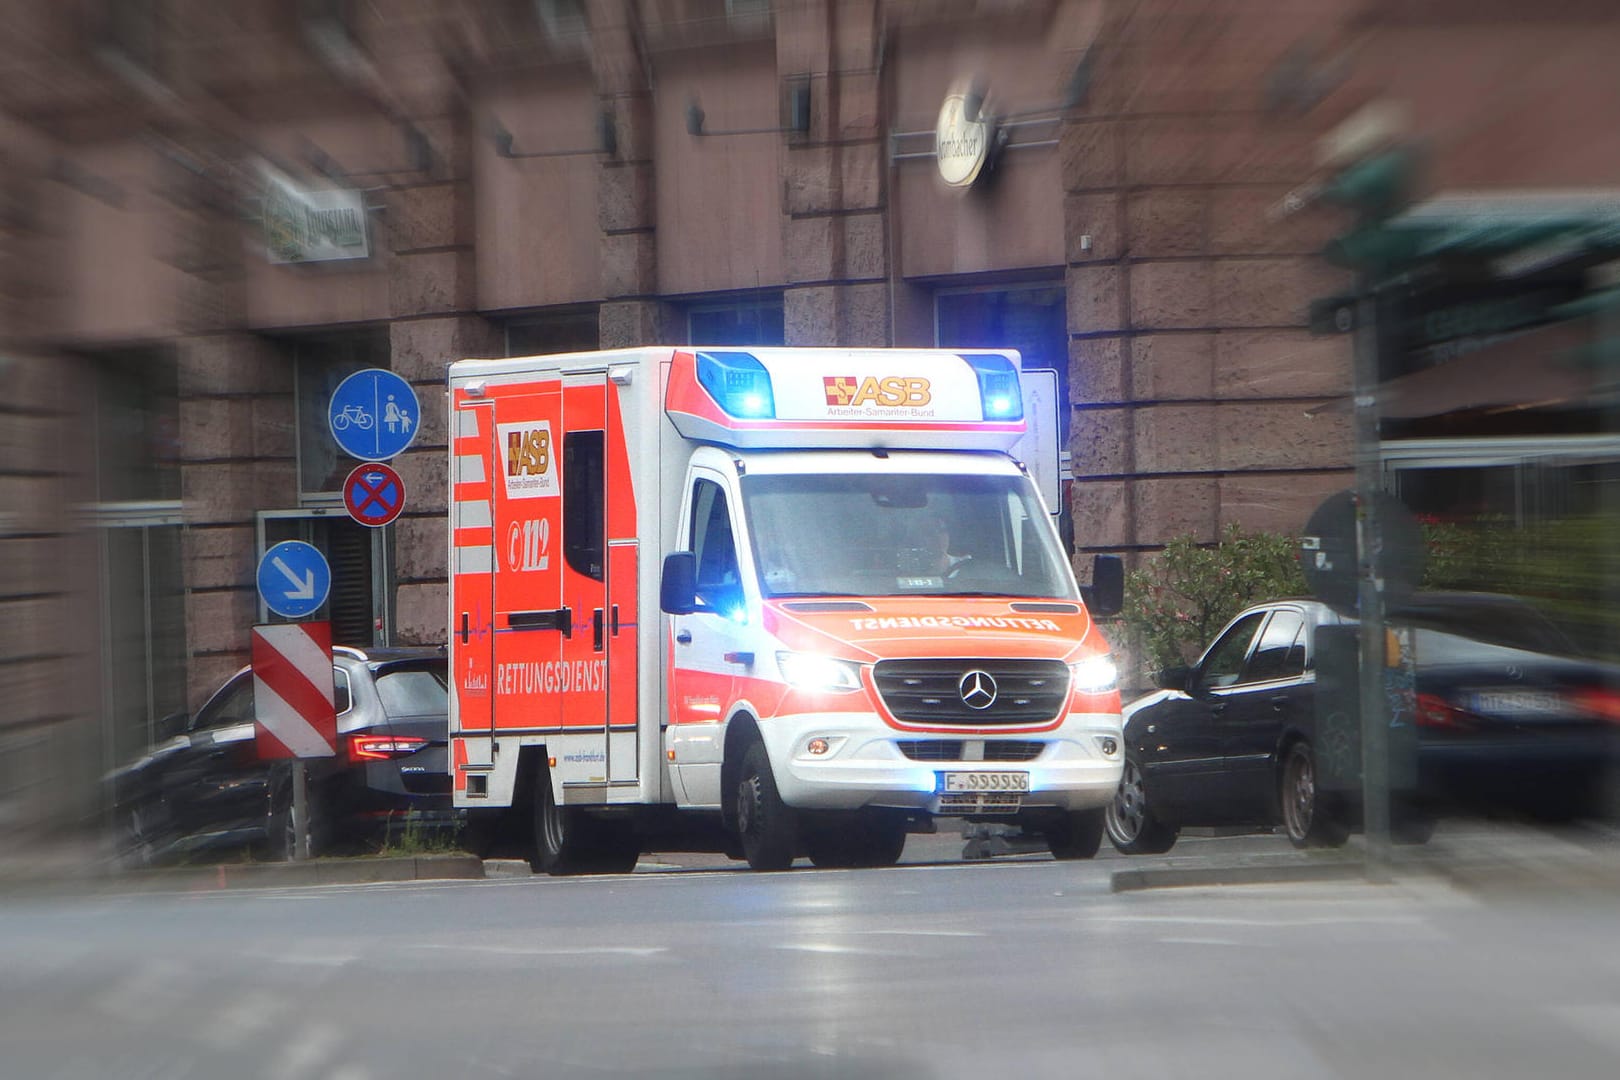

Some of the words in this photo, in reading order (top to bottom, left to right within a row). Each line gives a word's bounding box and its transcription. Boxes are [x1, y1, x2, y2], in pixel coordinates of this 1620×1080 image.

[852, 376, 932, 407] ASB
[517, 429, 550, 476] ASB
[521, 518, 549, 572] 112
[497, 659, 607, 695] RETTUNGSDIENST
